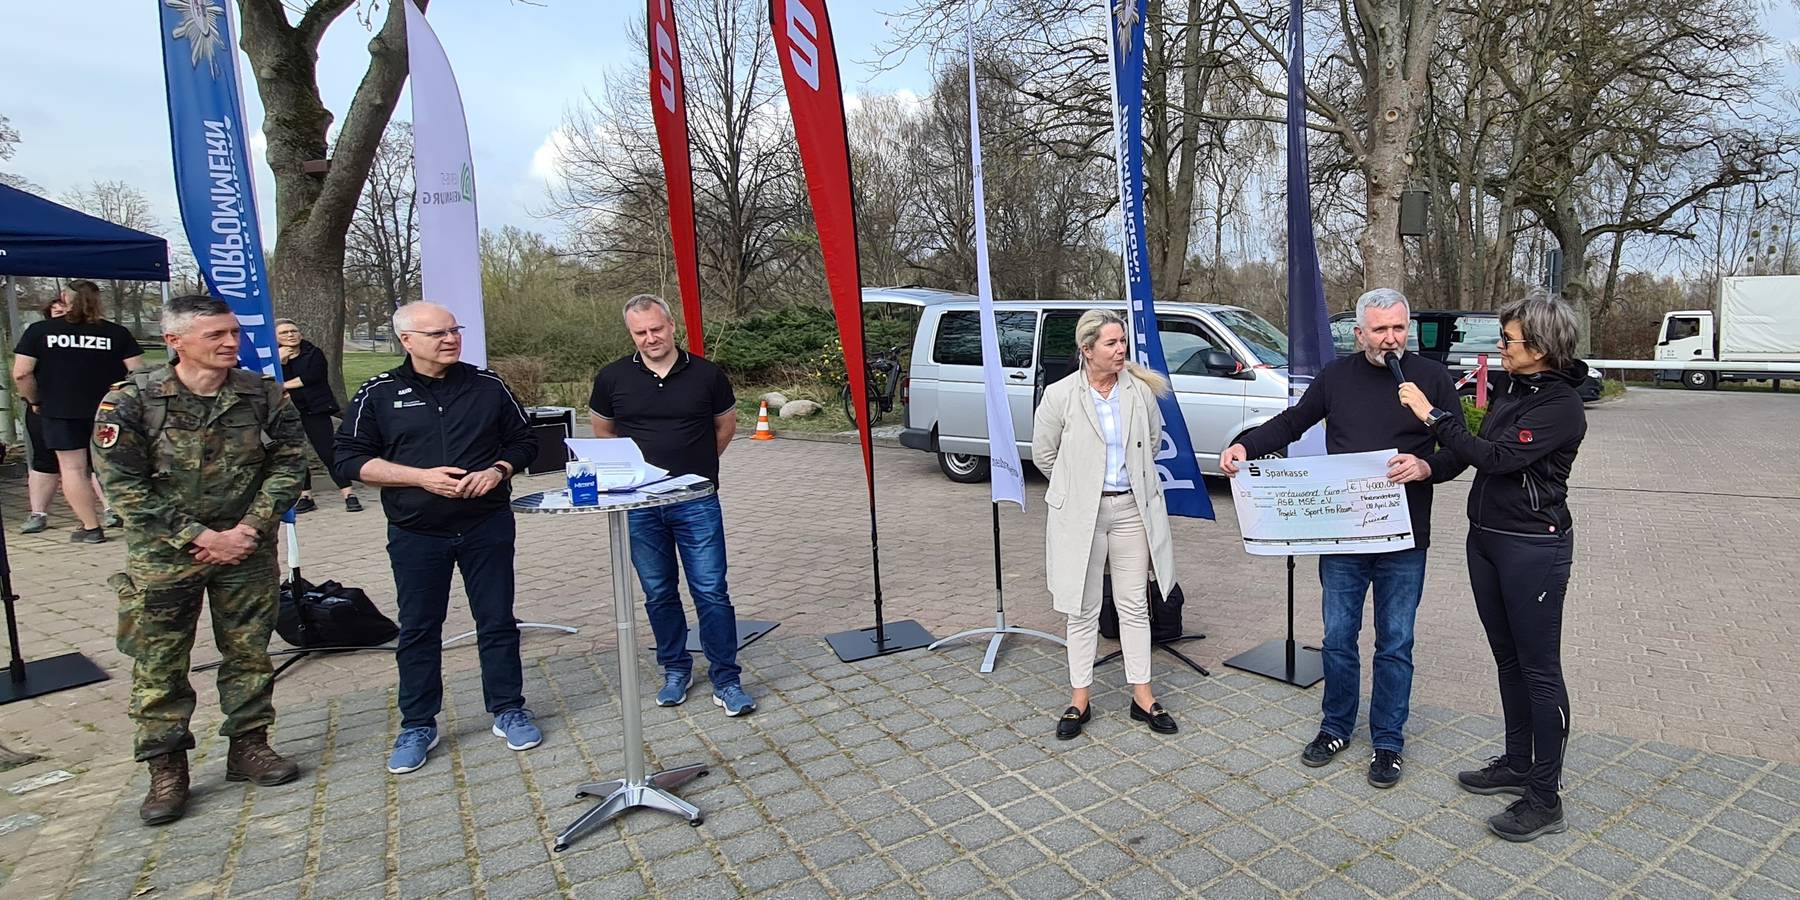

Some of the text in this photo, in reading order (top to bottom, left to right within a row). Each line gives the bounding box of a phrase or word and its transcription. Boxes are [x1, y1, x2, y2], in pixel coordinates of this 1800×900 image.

[47, 335, 111, 350] POLIZEI
[1265, 469, 1309, 479] Sparkasse
[1278, 498, 1295, 506] ASB
[1299, 497, 1316, 506] MSE
